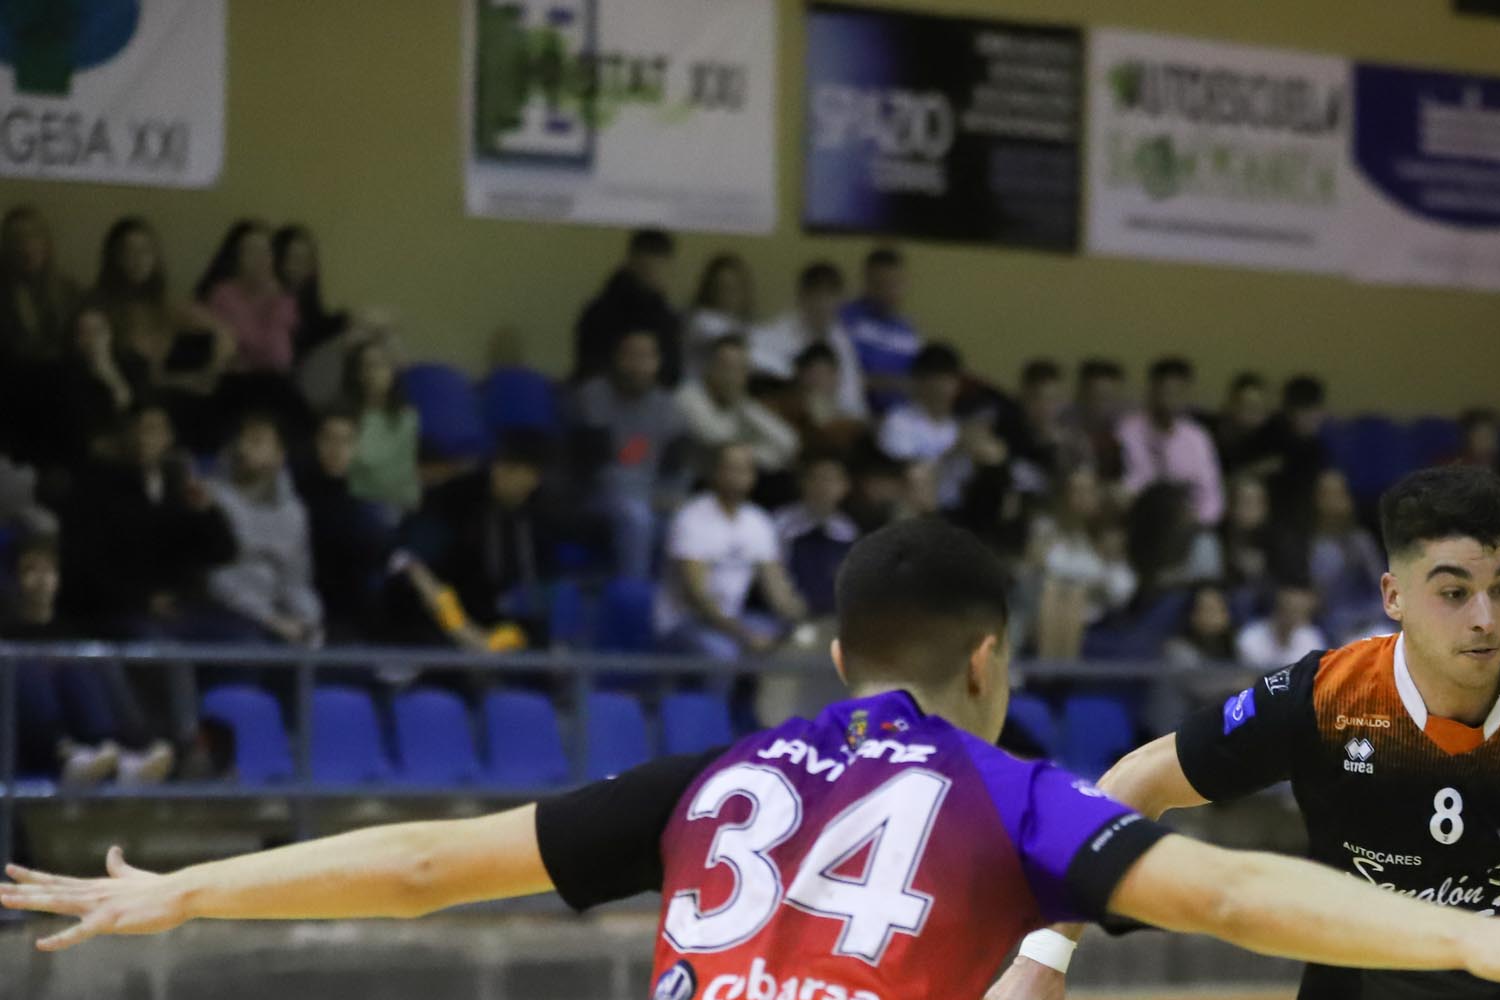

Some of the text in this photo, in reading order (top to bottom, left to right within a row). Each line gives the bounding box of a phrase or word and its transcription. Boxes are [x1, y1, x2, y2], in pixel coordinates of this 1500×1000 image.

[757, 738, 846, 782] JAVI
[1429, 786, 1464, 845] 8
[662, 762, 952, 968] 34
[1343, 841, 1422, 866] AUTOCARES
[1346, 856, 1484, 906] Salón
